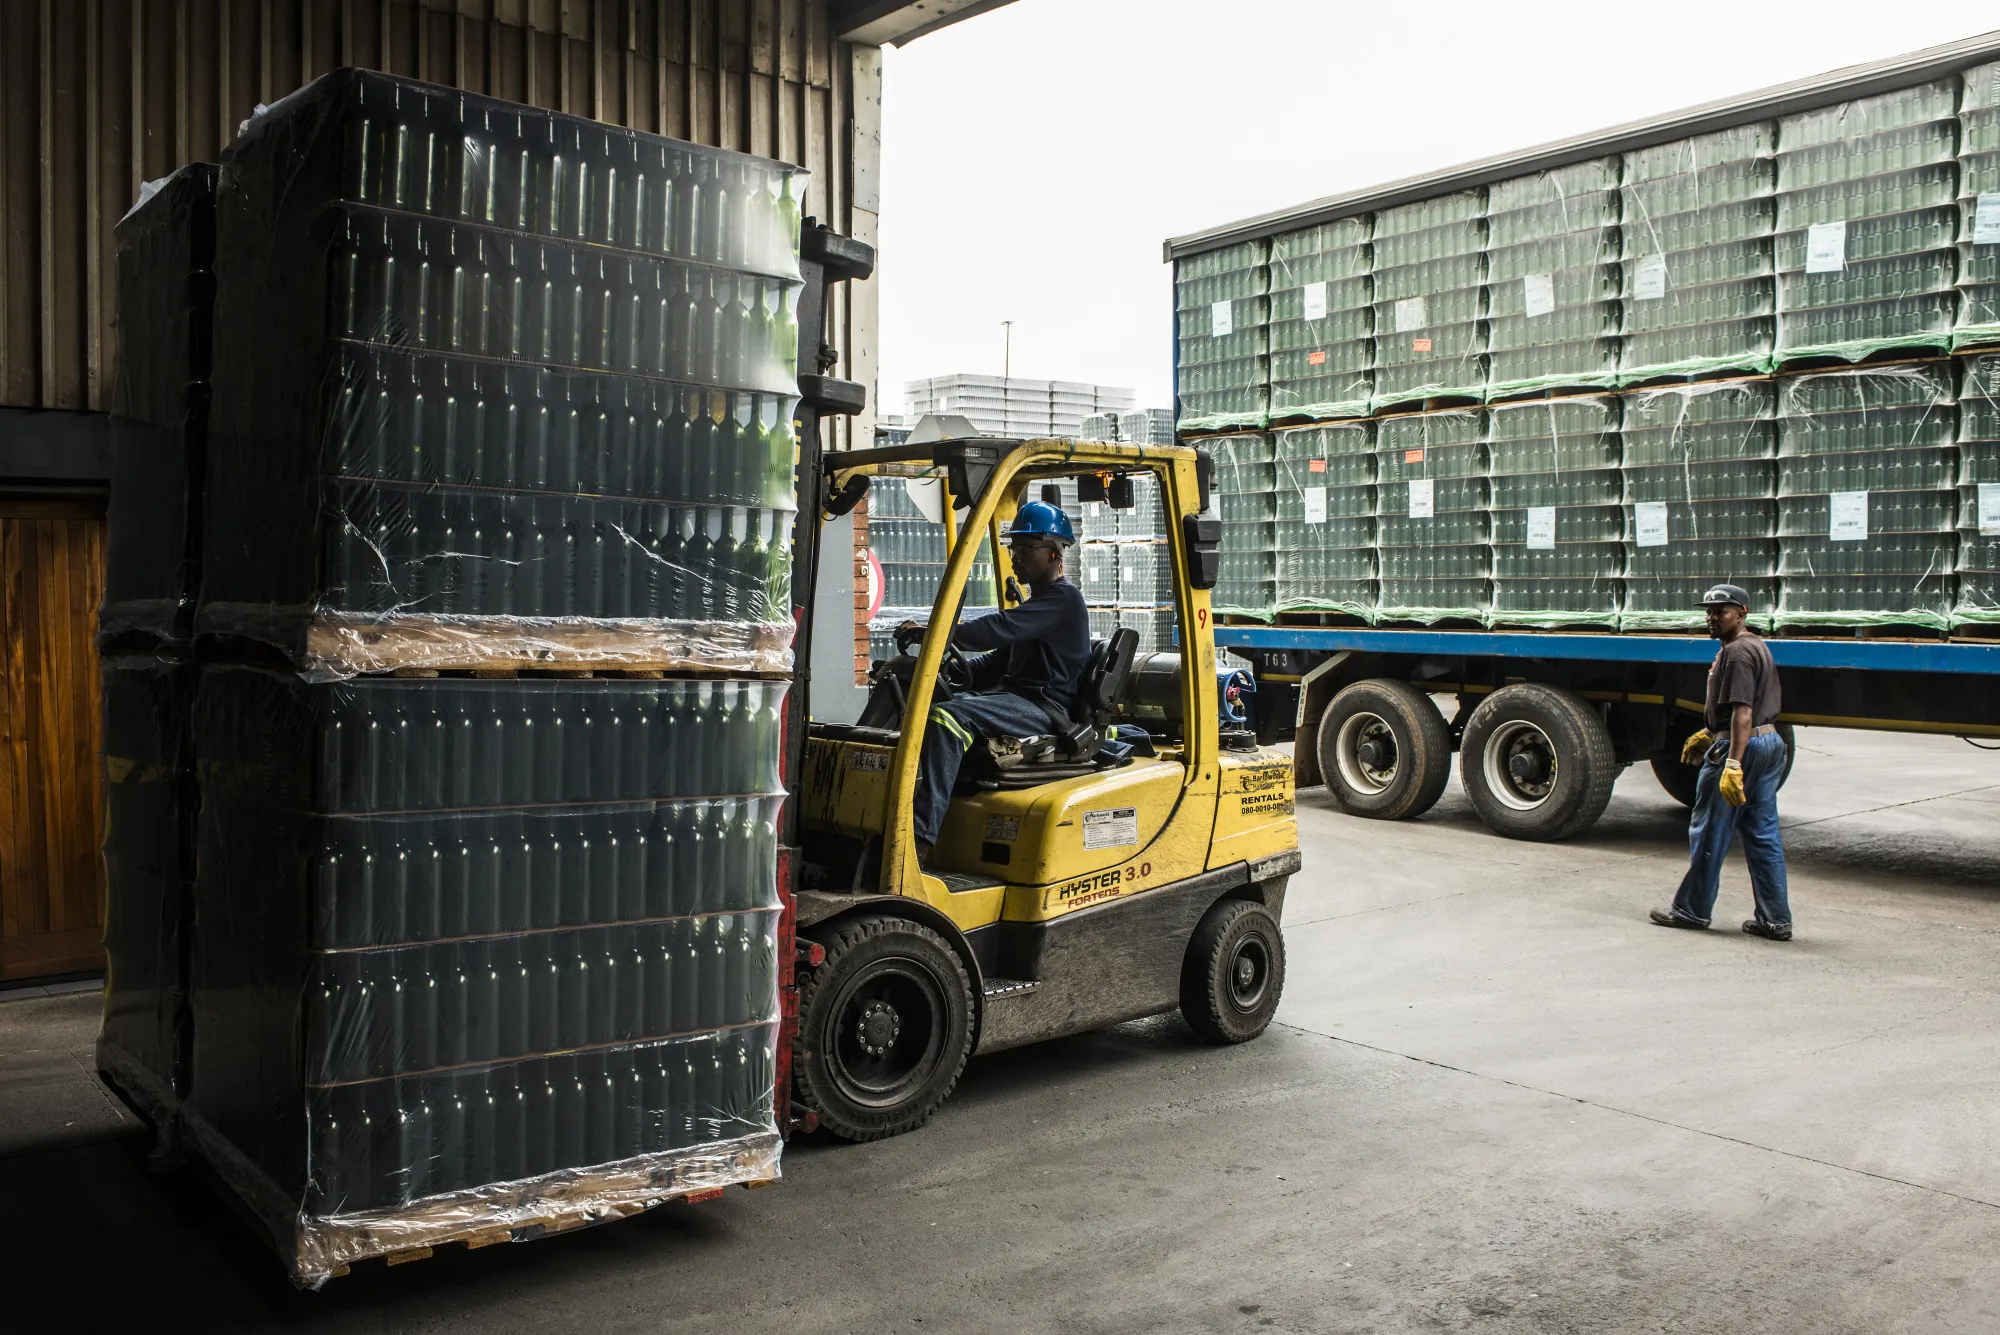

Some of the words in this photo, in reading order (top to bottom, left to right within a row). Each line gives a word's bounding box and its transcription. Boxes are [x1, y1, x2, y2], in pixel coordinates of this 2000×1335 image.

[1198, 608, 1207, 629] 9
[1264, 653, 1287, 666] T63
[1241, 793, 1284, 805] RENTALS
[1060, 870, 1121, 900] HYSTER
[1125, 862, 1152, 881] 3.0
[1068, 886, 1120, 908] FORTENS
